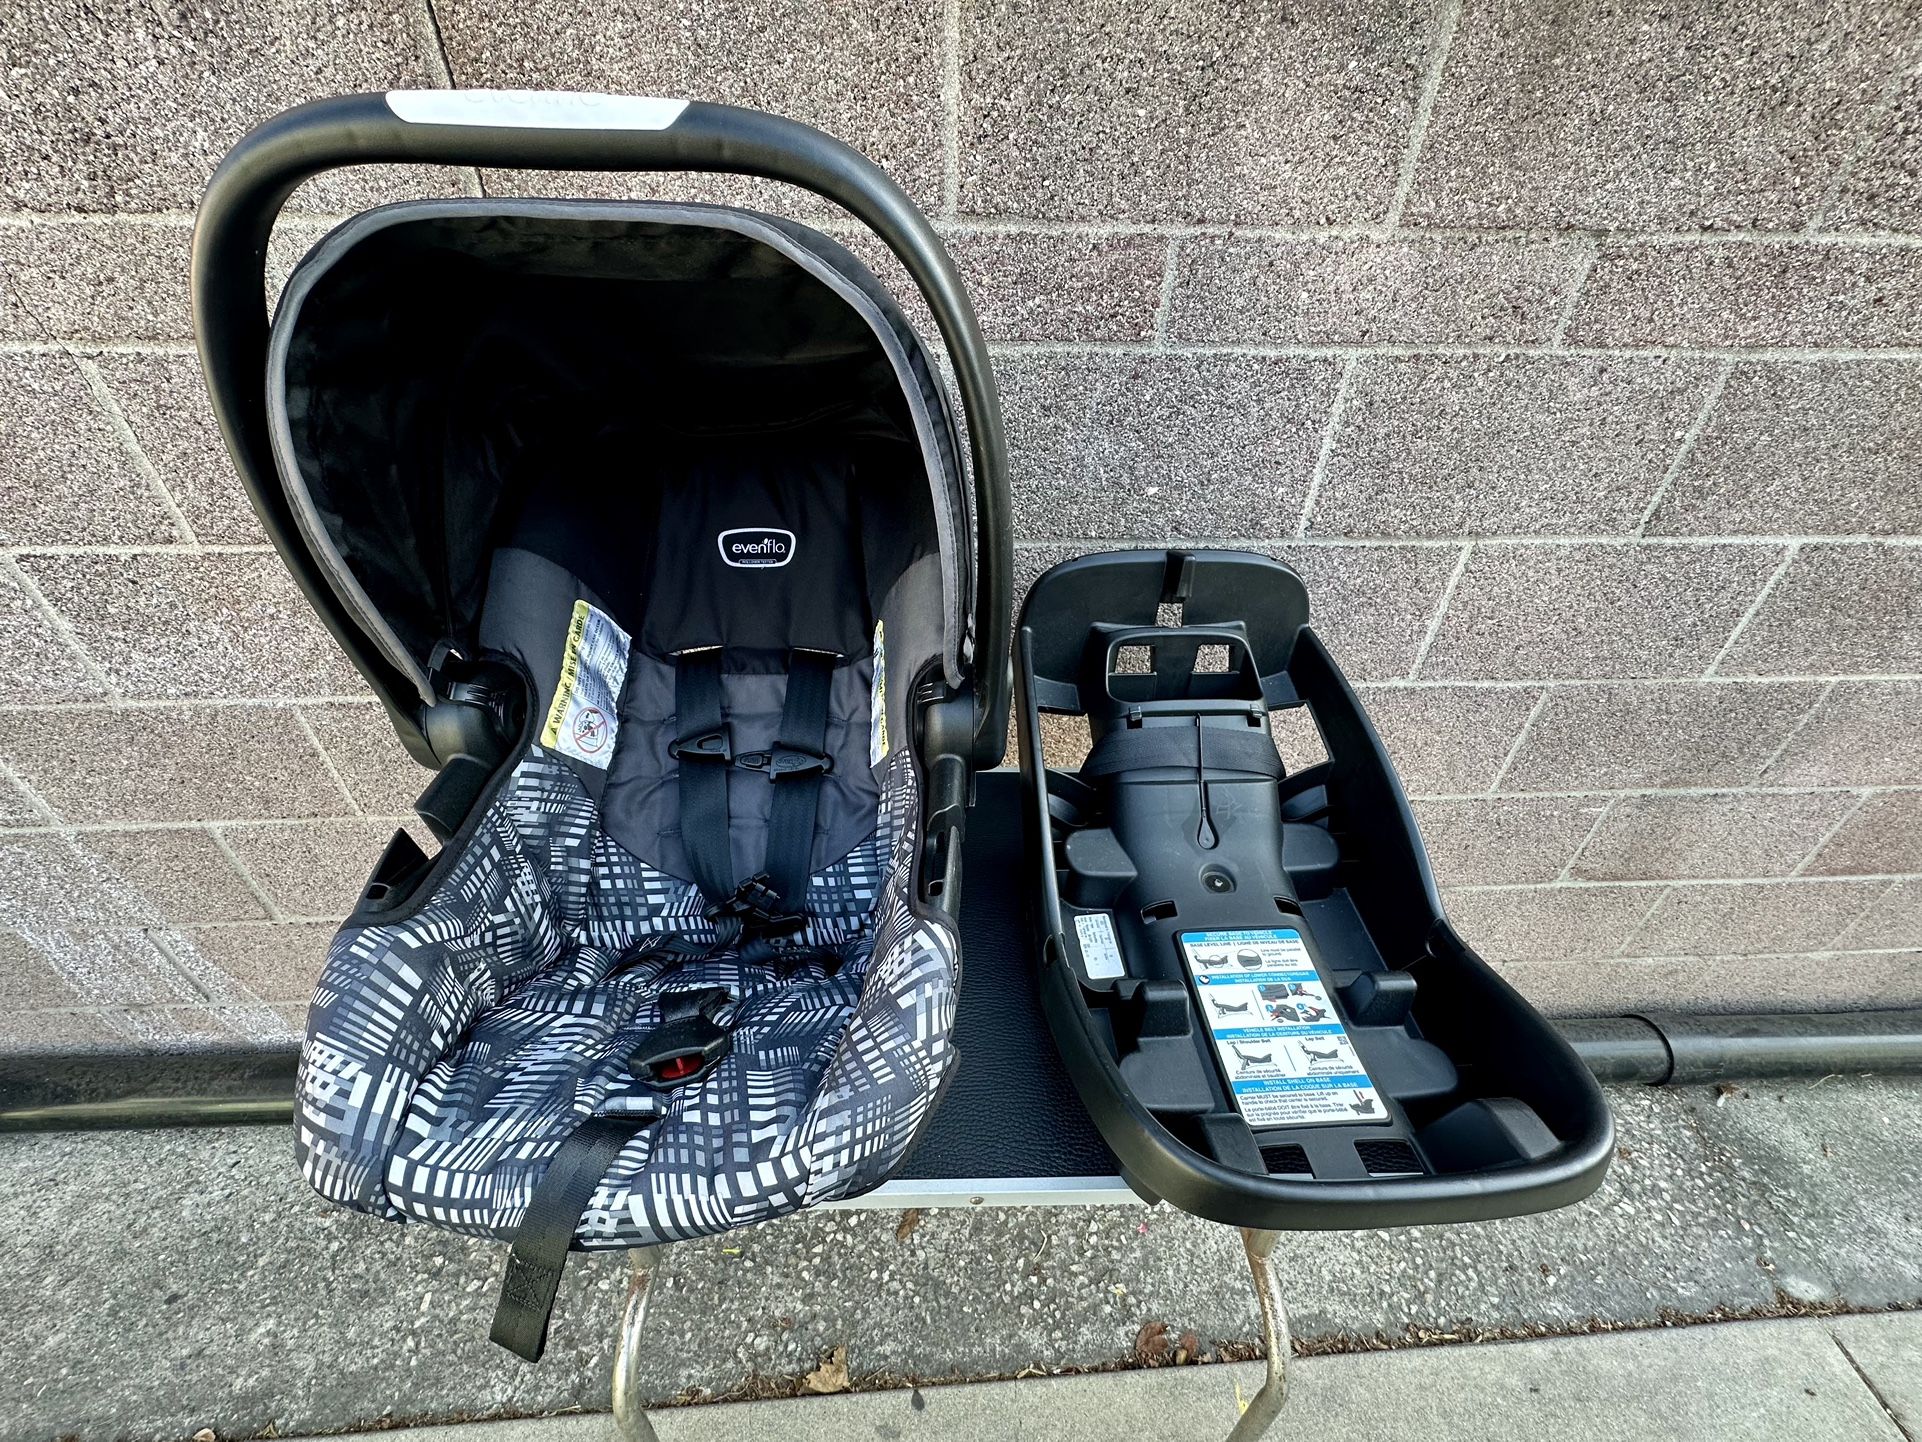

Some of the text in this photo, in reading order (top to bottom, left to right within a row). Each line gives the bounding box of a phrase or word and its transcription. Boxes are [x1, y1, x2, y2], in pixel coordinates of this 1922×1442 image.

[732, 539, 785, 553] evenflo
[553, 682, 571, 724] WARNING
[567, 656, 577, 677] MISE
[573, 615, 585, 642] GARDE
